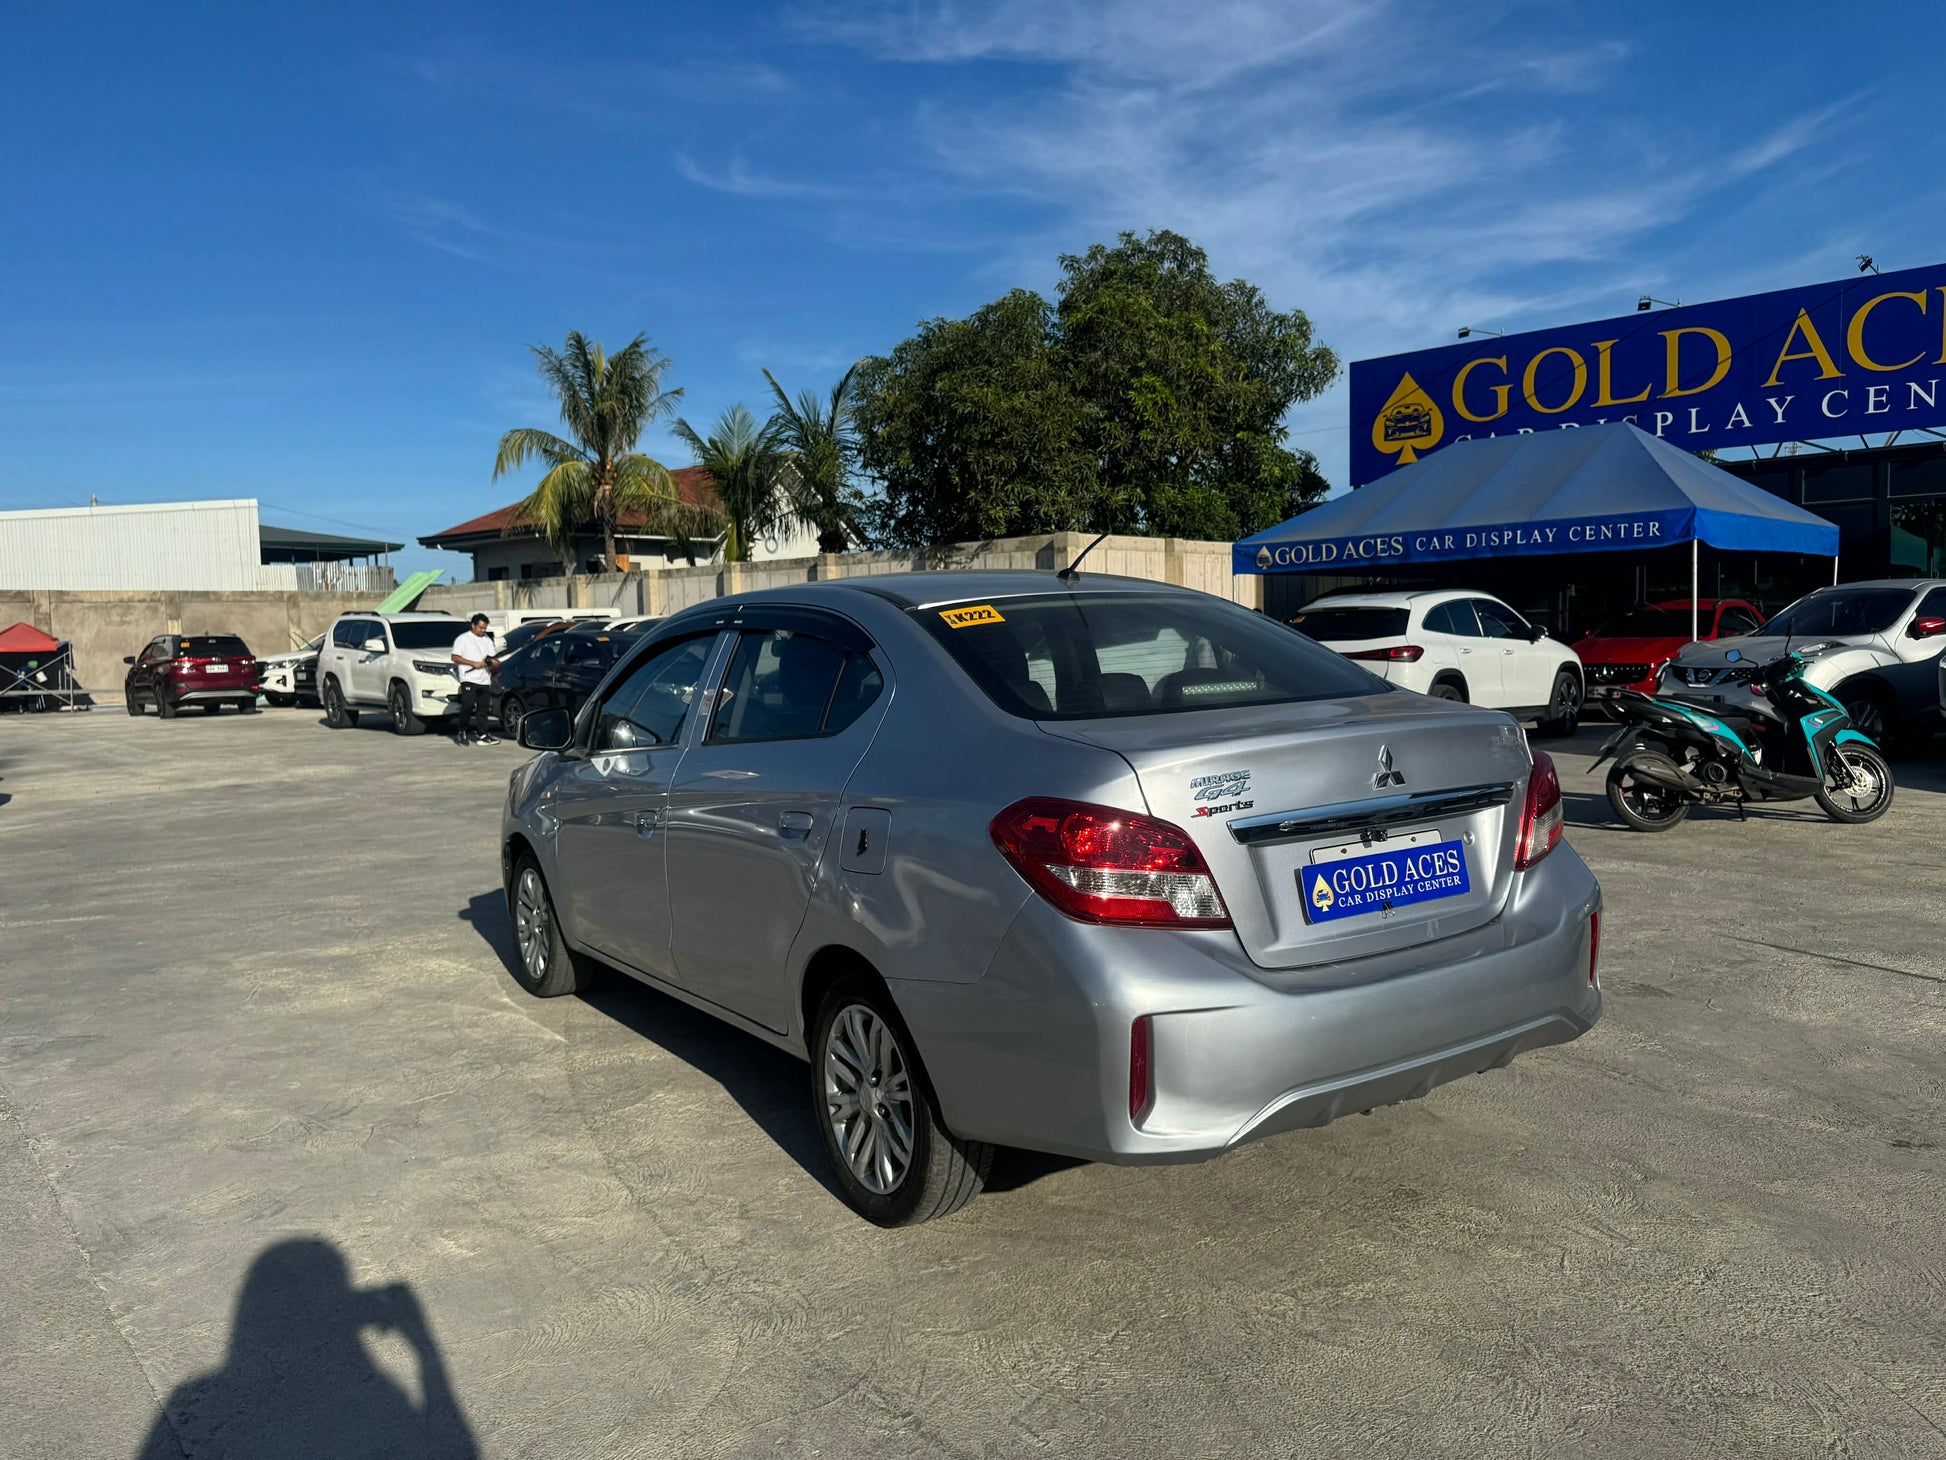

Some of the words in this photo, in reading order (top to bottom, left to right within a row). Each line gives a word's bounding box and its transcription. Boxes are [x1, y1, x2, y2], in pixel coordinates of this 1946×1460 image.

[1452, 326, 1732, 423] GOLD
[1760, 286, 1946, 388] AC
[1558, 395, 1795, 438] PLAY
[1275, 543, 1337, 566] GOLD
[1342, 536, 1404, 560] ACES
[1416, 535, 1455, 551] CAR
[1466, 528, 1558, 548] DISPLAY
[1569, 521, 1662, 542] CENTER
[1190, 769, 1251, 789] MIRAGE
[1194, 780, 1251, 801] G4
[1191, 800, 1255, 818] Sports
[1333, 861, 1399, 894] GOLD
[1404, 849, 1461, 882] ACES
[1338, 894, 1363, 908] CAR
[1366, 884, 1414, 902] DISPLAY
[1417, 875, 1462, 893] CENTER
